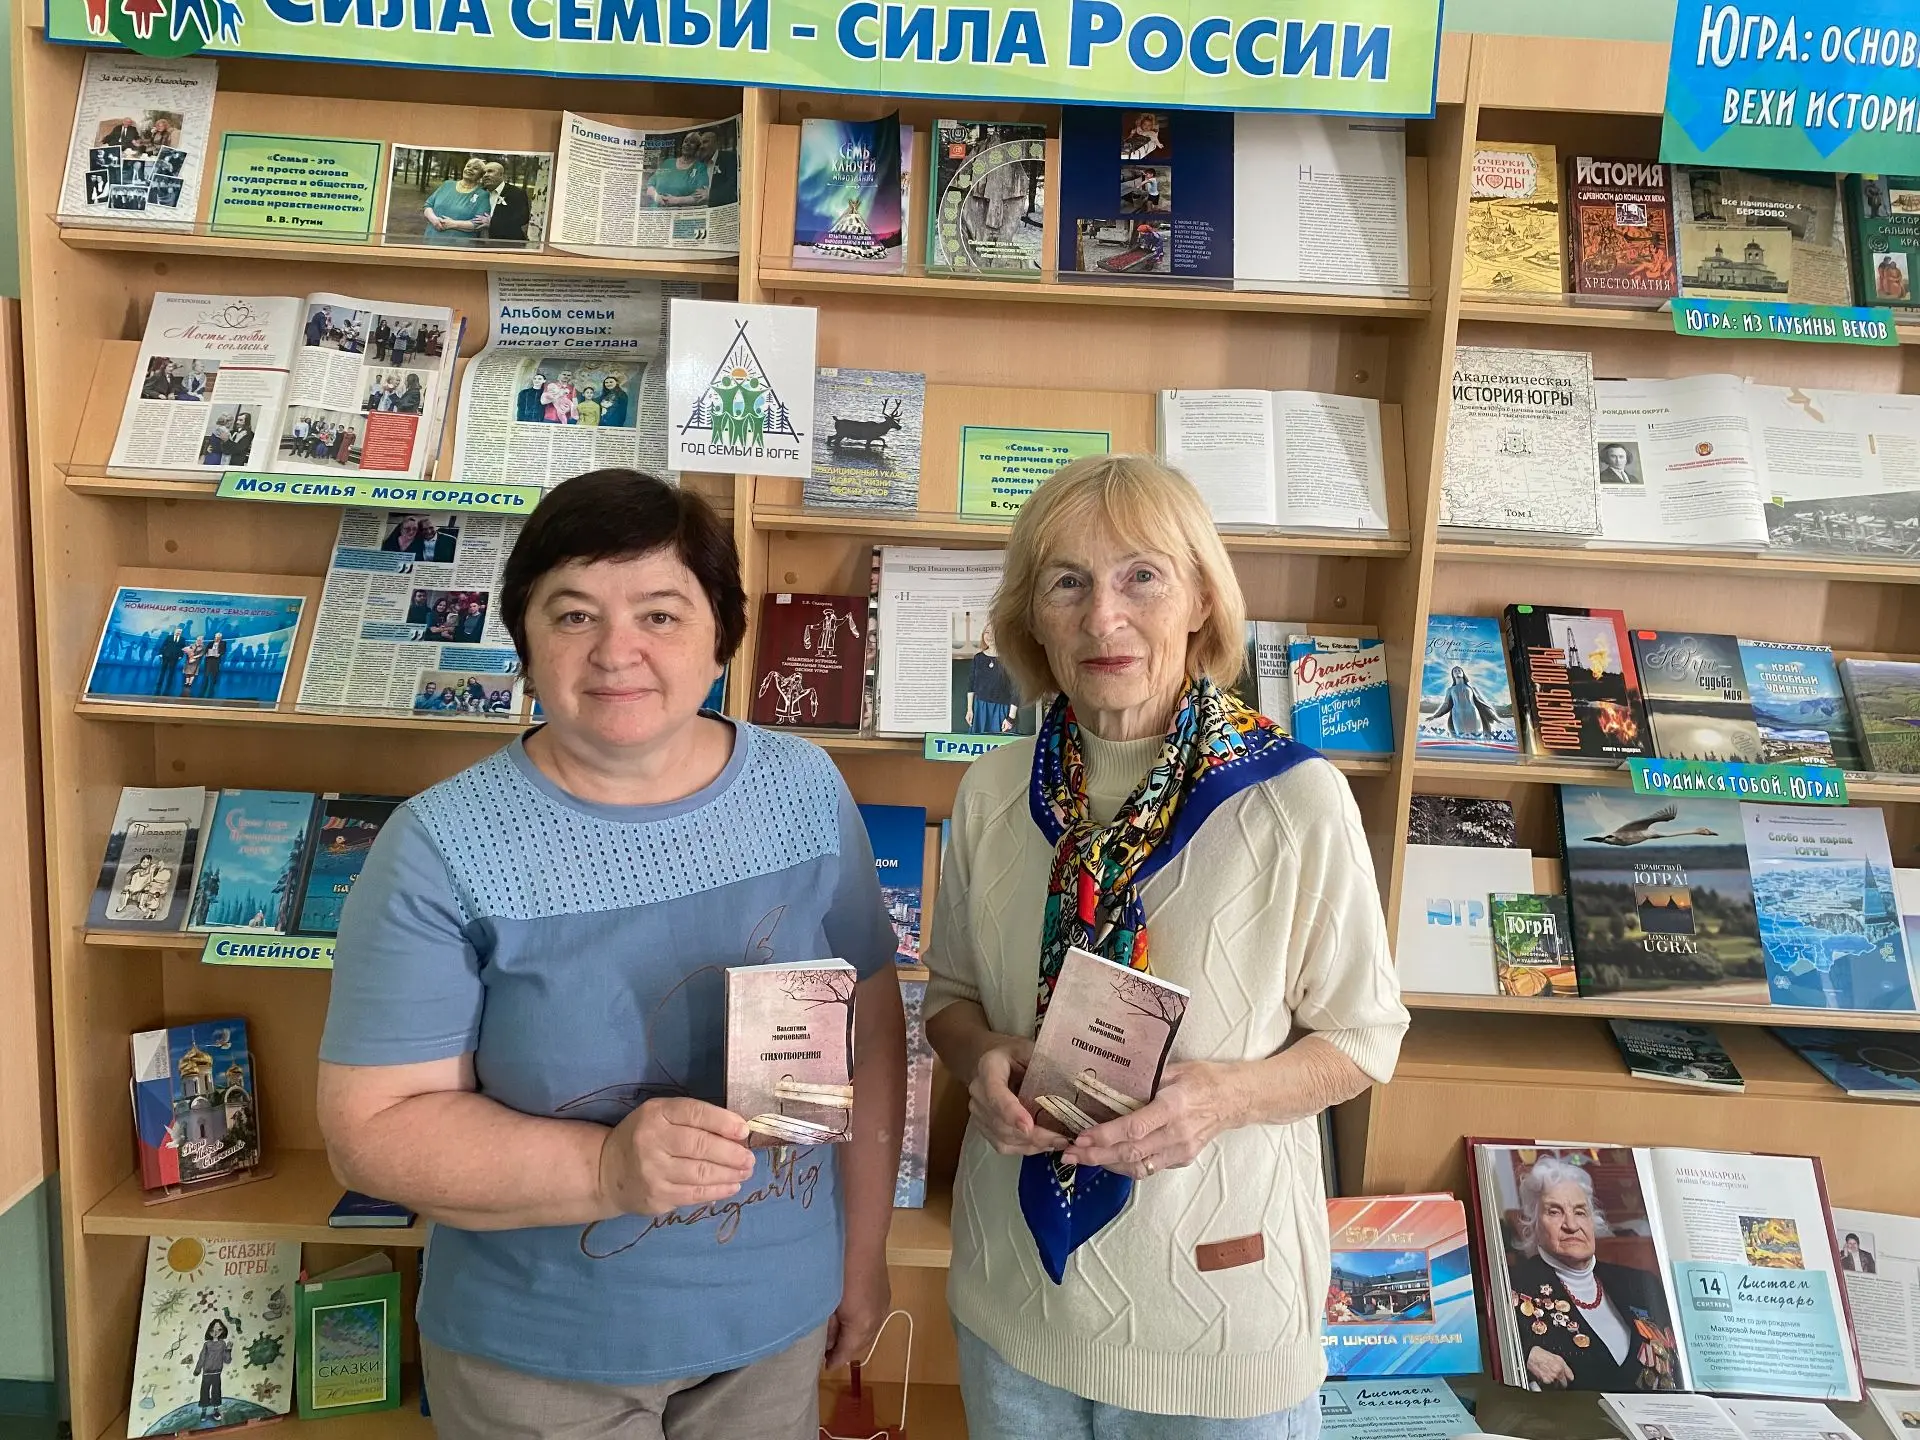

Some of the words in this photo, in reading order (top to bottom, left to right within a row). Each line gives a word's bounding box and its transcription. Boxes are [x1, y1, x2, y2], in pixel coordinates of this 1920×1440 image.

[511, 0, 768, 51] СЕМЬИ
[836, 2, 1049, 67] СИЛА
[1696, 4, 1814, 68] ЮГРА:
[1821, 24, 1920, 69] ОСНОВ
[1722, 86, 1798, 128] ВЕХИ
[1804, 90, 1920, 134] ИСТОРИ
[571, 124, 621, 145] Полвека
[623, 137, 637, 147] на
[839, 142, 871, 160] СЕМЬ
[267, 153, 309, 164] «Семья
[317, 158, 336, 166] это
[831, 158, 877, 173] КЛЮЧЕЙ
[1477, 158, 1526, 167] ОЧЕРКИ
[250, 164, 264, 172] не
[267, 165, 306, 176] просто
[308, 168, 349, 178] основа
[1472, 165, 1531, 175] ИСТОРИИ
[1576, 160, 1665, 188] ИСТОРИЯ
[227, 174, 298, 186] государства
[309, 179, 368, 191] общества,
[231, 186, 250, 194] это
[251, 187, 308, 198] духовное
[310, 191, 363, 202] явление,
[1583, 192, 1615, 201] ДРЕВНОСТИ
[1615, 193, 1624, 201] ДО
[1624, 193, 1643, 202] КОНЦА
[1652, 194, 1666, 203] ВЕКА
[223, 197, 265, 207] основа
[266, 200, 365, 213] нравственности»
[1721, 197, 1737, 208] Все
[1739, 199, 1795, 210] начиналось
[1736, 207, 1788, 219] БЕРЕЗОВО.
[266, 215, 277, 223] В.
[278, 216, 289, 224] В.
[291, 217, 323, 227] Путин
[1584, 277, 1671, 292] ХРЕСТОМАТИЯ
[500, 305, 562, 319] Альбом
[567, 308, 615, 320] семьи
[500, 323, 613, 338] Недоцуковых:
[1685, 309, 1738, 331] ЮГРА:
[1743, 312, 1763, 332] ИЗ
[1768, 314, 1837, 338] ГЛУБИНЫ
[1841, 318, 1888, 340] ВЕКОВ
[163, 324, 226, 341] Мосты
[217, 342, 269, 351] согласия
[497, 339, 560, 348] листает
[564, 338, 639, 348] Светлана
[1453, 370, 1573, 387] Академическая
[1452, 385, 1523, 404] ИСТОРИЯ
[1528, 390, 1573, 406] ЮГРЫ
[681, 442, 706, 457] ГОД
[708, 444, 752, 458] СЕМЬИ
[755, 446, 763, 458] В
[766, 447, 800, 461] ЮГРЕ
[1005, 443, 1044, 453] «Семья
[994, 455, 1054, 465] первичная
[1002, 466, 1020, 474] где
[991, 476, 1034, 485] должен
[235, 477, 286, 494] МОЯ
[290, 482, 356, 498] СЕМЬЯ
[371, 485, 416, 502] МОЯ
[420, 489, 525, 506] ГОРДОСТЬ
[1504, 509, 1526, 518] Том
[927, 564, 965, 573] Ивановна
[124, 602, 177, 612] НОМИНАЦИЯ
[1294, 653, 1381, 686] Юганские
[1314, 671, 1372, 697] ханты:
[1700, 676, 1732, 692] судьба
[1759, 672, 1819, 686] СПОСОБНЫЙ
[1723, 690, 1742, 701] моя
[1766, 682, 1817, 696] УДИВЛЯТЬ
[1321, 696, 1361, 715] ИСТОРИЯ
[1321, 710, 1343, 726] БЫТ
[1322, 717, 1370, 738] КУЛЬТУРА
[1800, 756, 1827, 765] ЮГРА
[1641, 768, 1726, 792] ГОРДИМСЯ
[1729, 776, 1787, 797] ТОБОЙ,
[1789, 776, 1840, 800] ЮГРА!
[1768, 832, 1799, 843] Слово
[1802, 836, 1816, 844] на
[1633, 871, 1689, 886] ЮГРА!
[1426, 897, 1484, 927] ЮГР
[216, 940, 321, 960] СЕМЕЙНОЕ
[1643, 939, 1698, 954] UGRA!
[760, 1050, 821, 1062] СТИХОТВОРЕНИЯ
[1071, 1036, 1132, 1068] СТИХОТВОРЕНИЯ
[1700, 1169, 1746, 1181] МАКАРОВА
[218, 1242, 277, 1260] СКАЗКИ
[224, 1259, 268, 1277] ЮГРЫ
[1699, 1277, 1722, 1296] 14
[1737, 1274, 1810, 1290] Листаем
[1696, 1300, 1730, 1309] СЕНТЯБРЬ
[1738, 1291, 1814, 1307] календарь
[1710, 1325, 1749, 1334] Макаровой
[1767, 1329, 1816, 1340] Лаврентьевны
[1343, 1335, 1398, 1346] ШКОЛА
[318, 1360, 380, 1378] СКАЗКИ
[1356, 1386, 1434, 1400] Листаем
[1358, 1396, 1442, 1408] календарь
